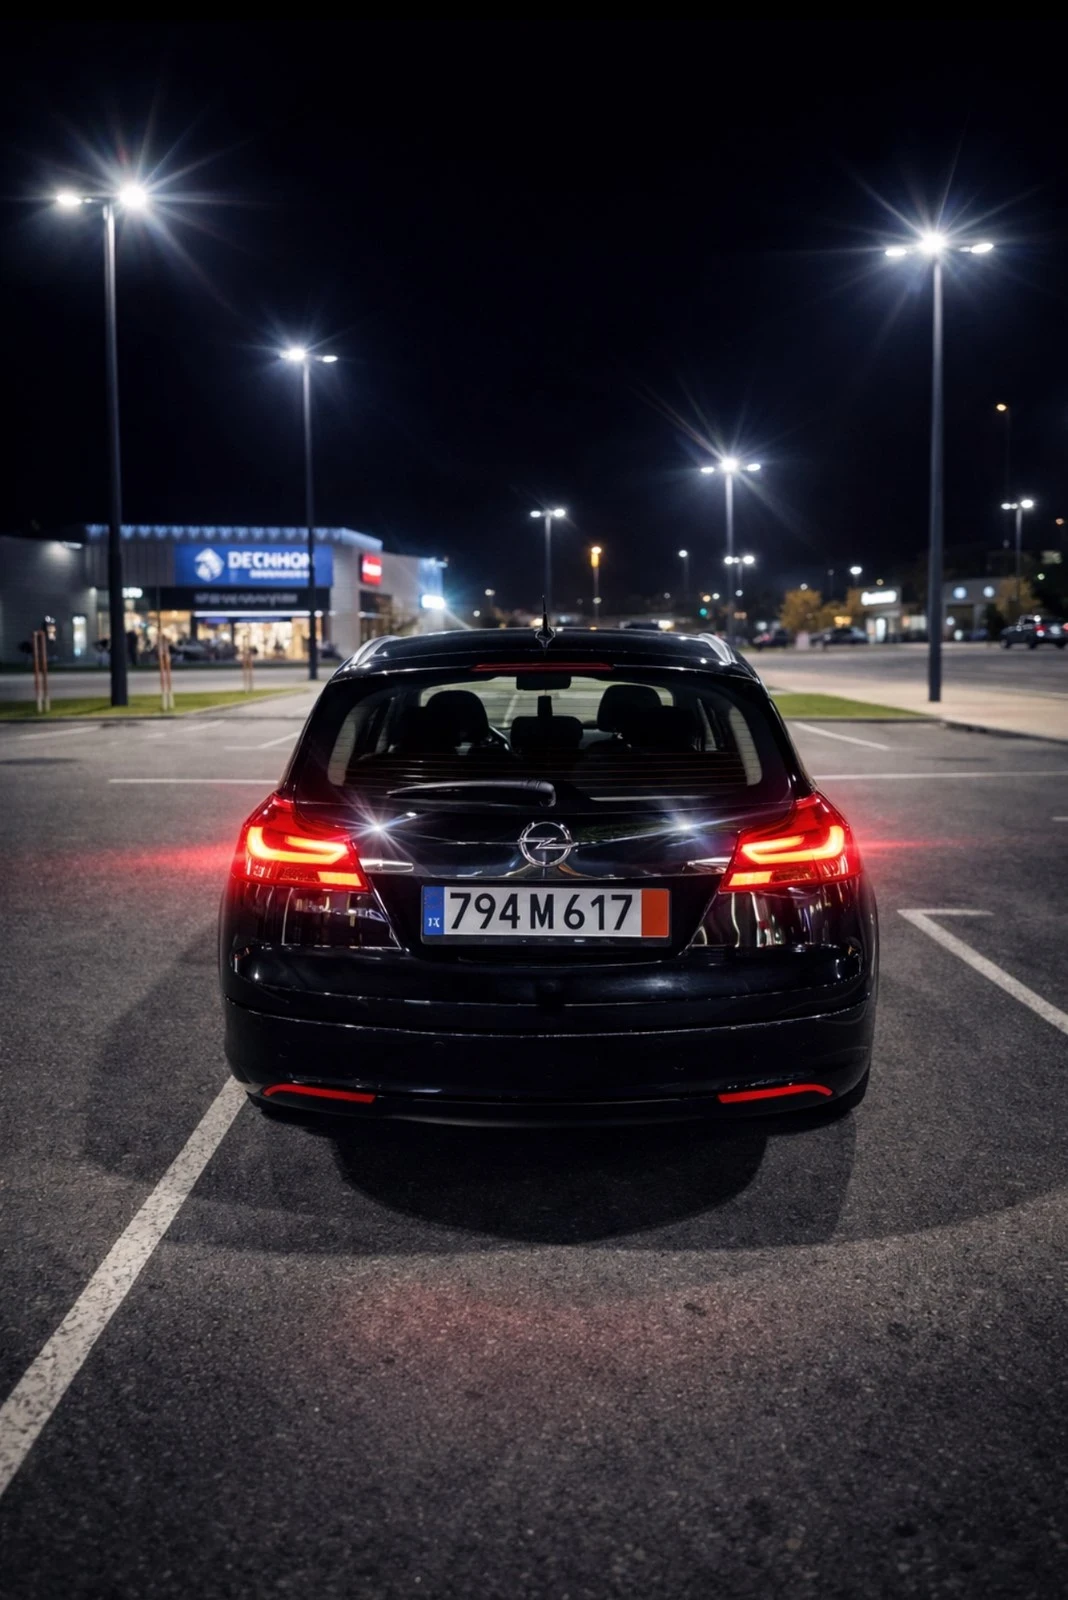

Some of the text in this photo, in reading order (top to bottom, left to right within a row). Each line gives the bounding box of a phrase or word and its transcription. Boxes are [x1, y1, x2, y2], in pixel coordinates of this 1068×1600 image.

[450, 893, 633, 931] 794 M 617
